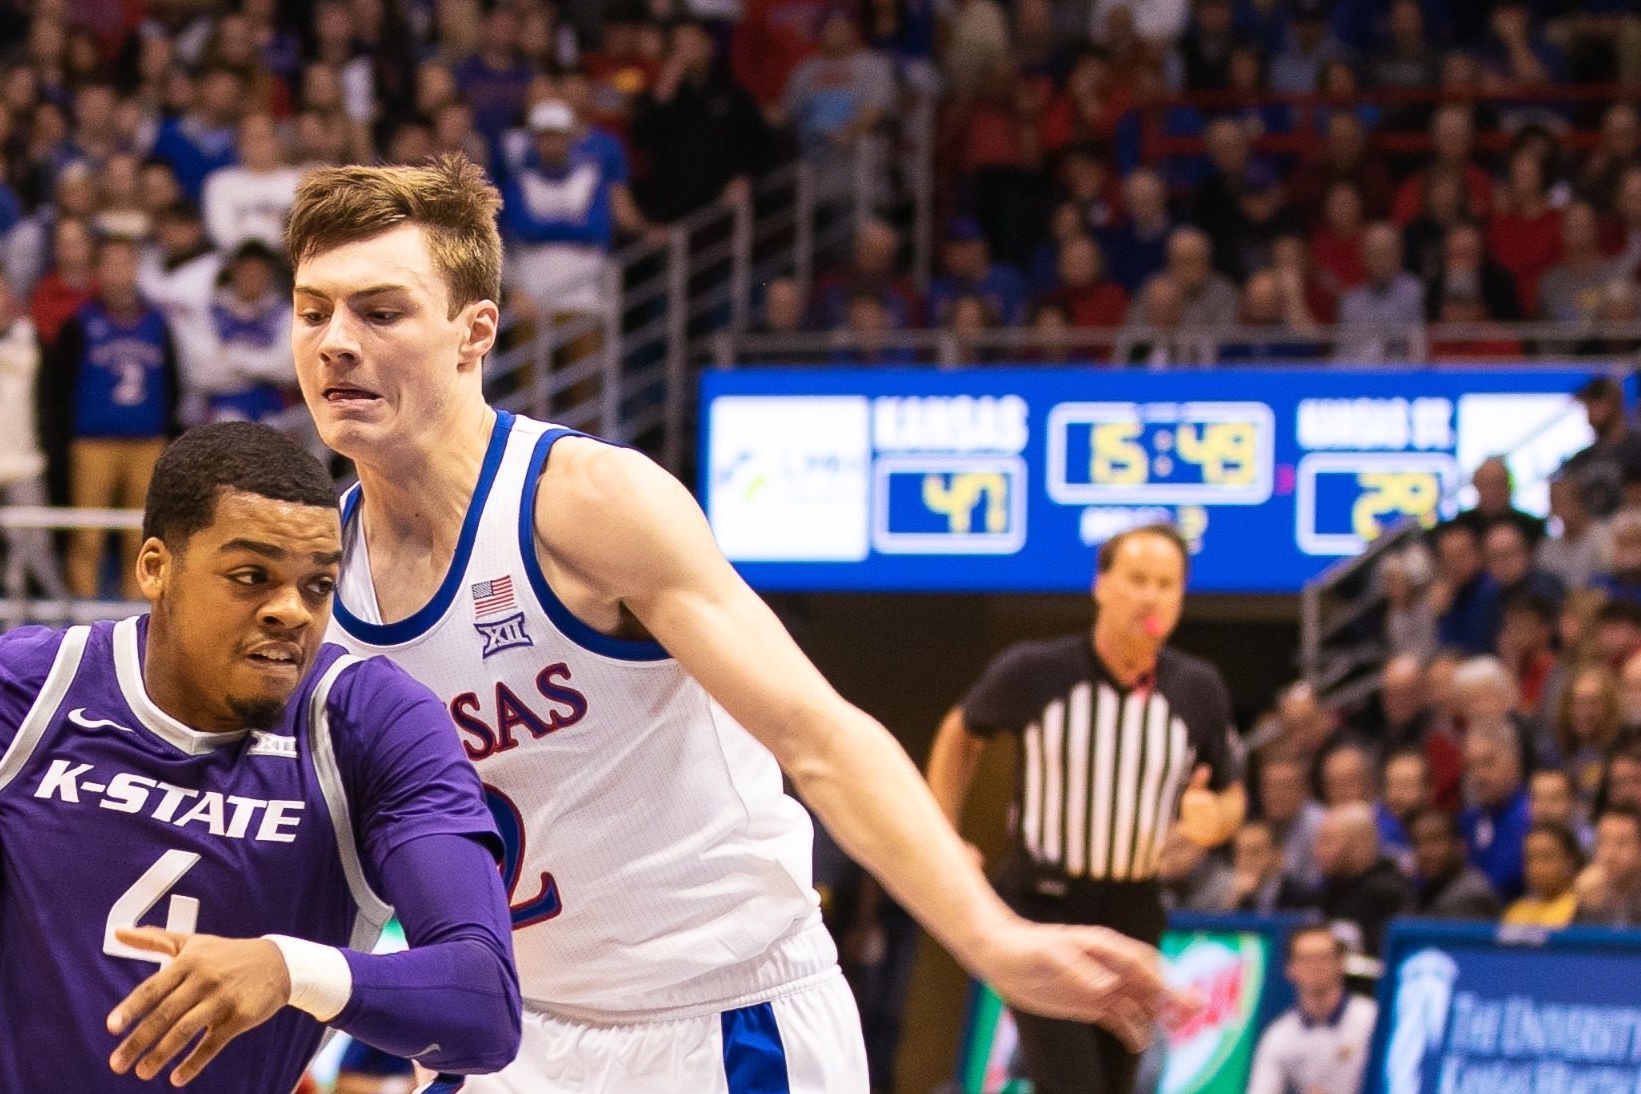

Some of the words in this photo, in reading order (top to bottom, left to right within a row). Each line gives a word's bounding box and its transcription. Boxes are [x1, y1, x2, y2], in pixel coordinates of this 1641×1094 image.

[473, 611, 534, 660] XII
[446, 661, 589, 762] SAS
[33, 759, 306, 844] K-STATE
[102, 848, 202, 972] 4
